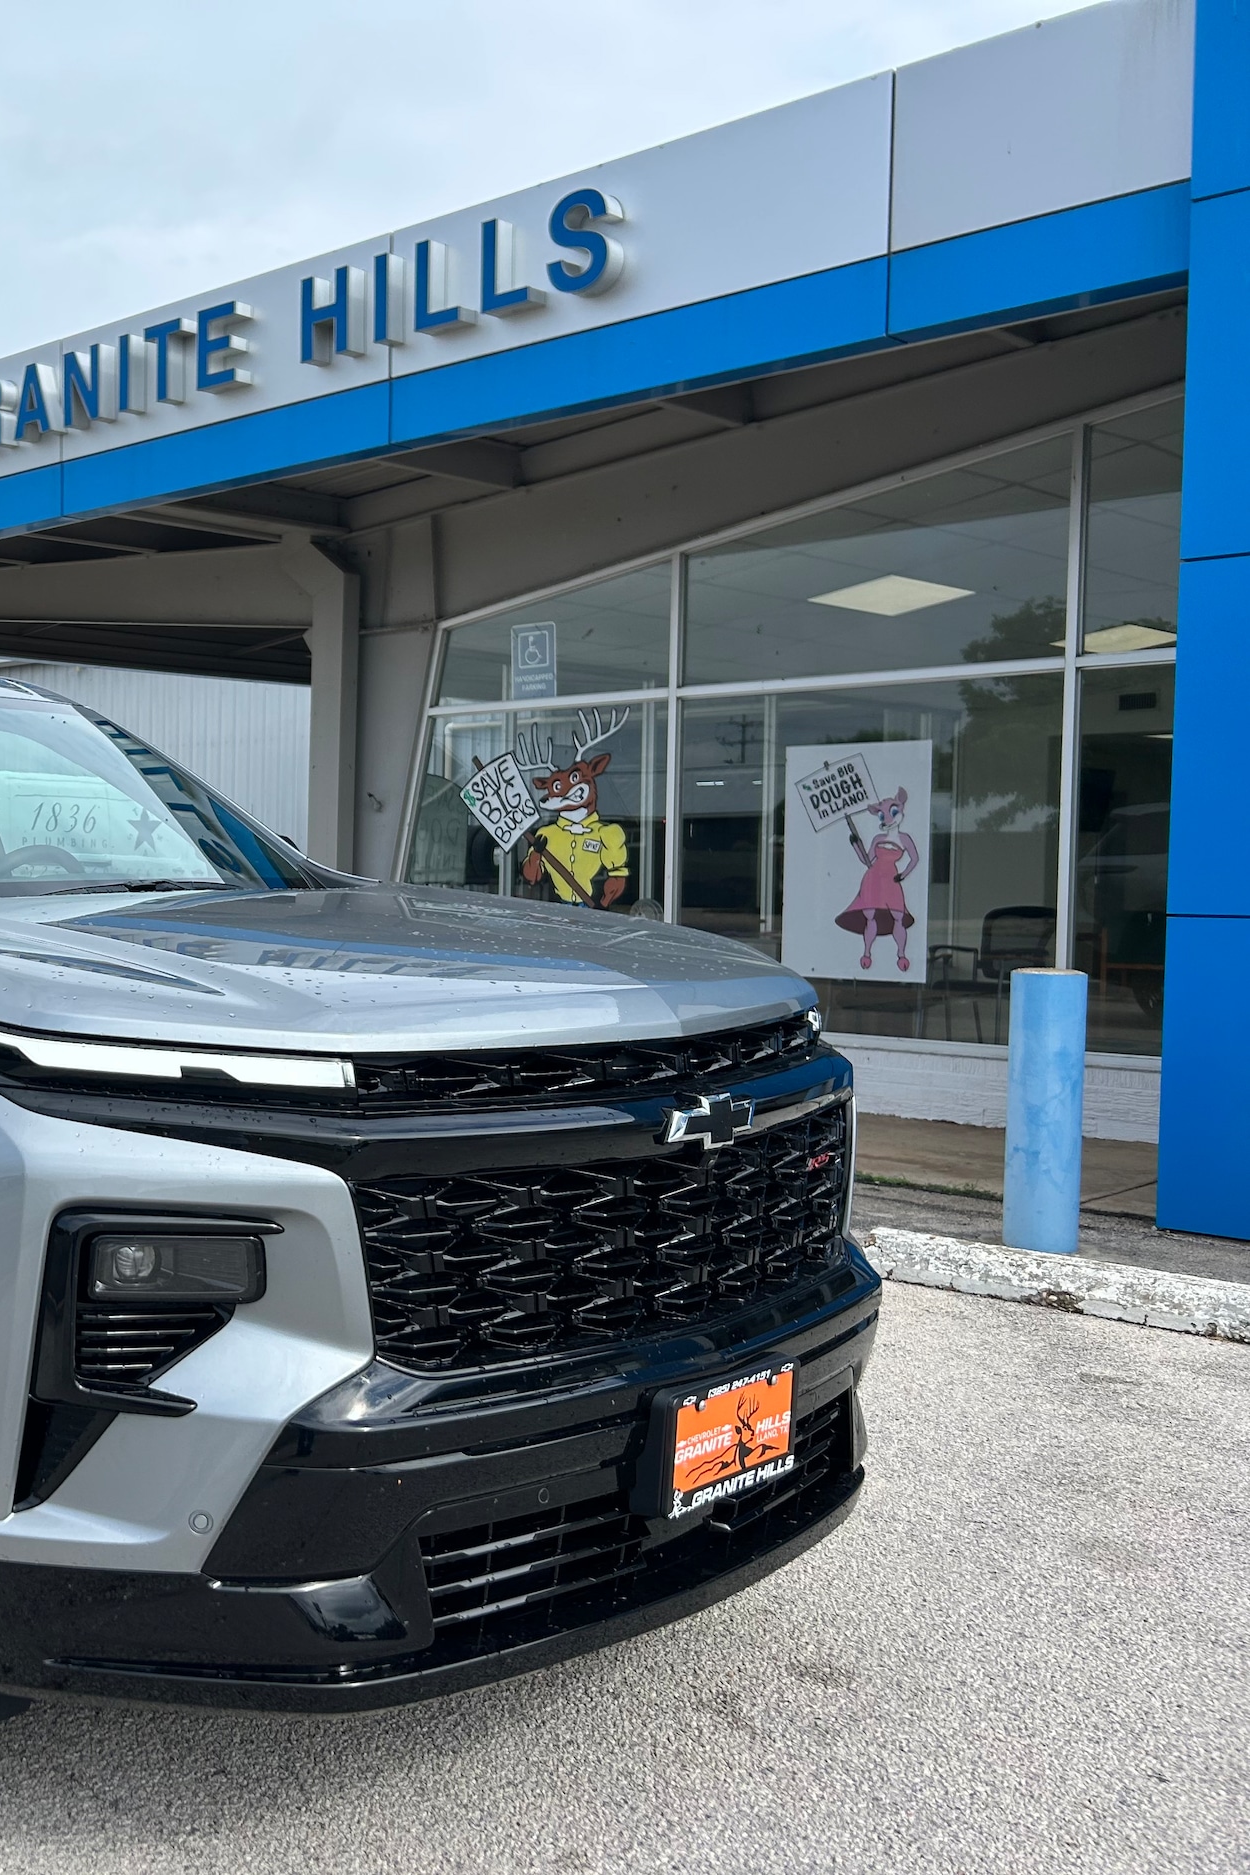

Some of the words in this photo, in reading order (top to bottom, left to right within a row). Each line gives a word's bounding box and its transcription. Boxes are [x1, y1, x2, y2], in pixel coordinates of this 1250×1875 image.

[299, 188, 624, 366] HILLS
[515, 672, 554, 683] HANDICAPPED
[522, 682, 547, 691] PARKING
[479, 782, 522, 825] BIG
[809, 772, 864, 810] DOUGH
[829, 788, 869, 814] LLANO!
[31, 801, 99, 834] 1836
[493, 798, 537, 844] BUCKS
[707, 1383, 730, 1399] (325)
[731, 1369, 771, 1390] 247-4151
[687, 1426, 722, 1445] CHEVROLET
[756, 1411, 791, 1434] HILLS
[780, 1427, 789, 1437] TX
[674, 1432, 733, 1464] GRANITE
[691, 1470, 756, 1507] GRANITE
[756, 1455, 795, 1482] HILLS
